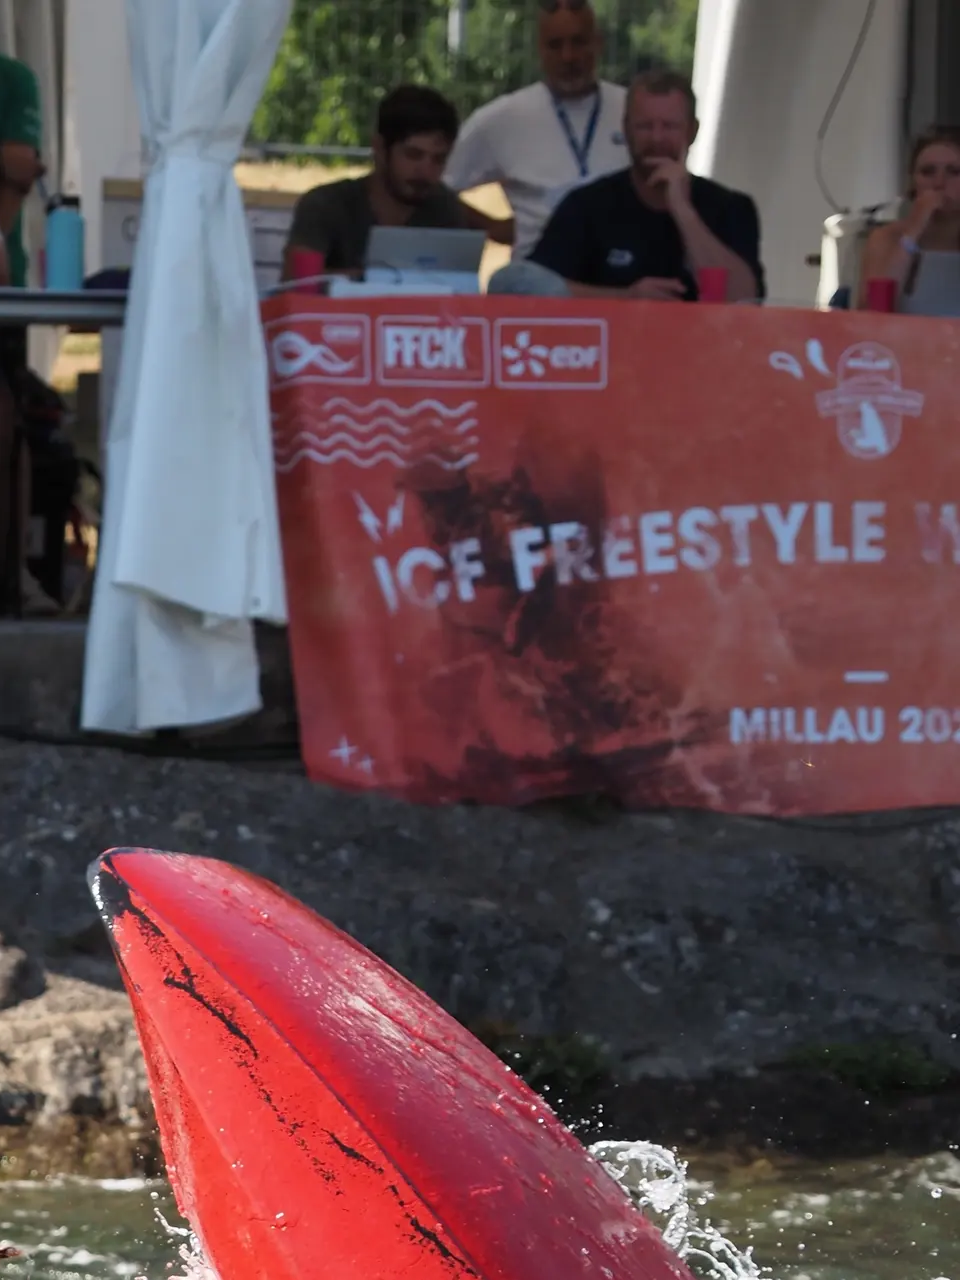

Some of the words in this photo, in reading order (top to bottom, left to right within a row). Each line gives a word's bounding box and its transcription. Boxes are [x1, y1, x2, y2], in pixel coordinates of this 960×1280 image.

[372, 537, 486, 615] ICF
[508, 501, 888, 593] FREESTYLE
[729, 706, 883, 743] MILLAU
